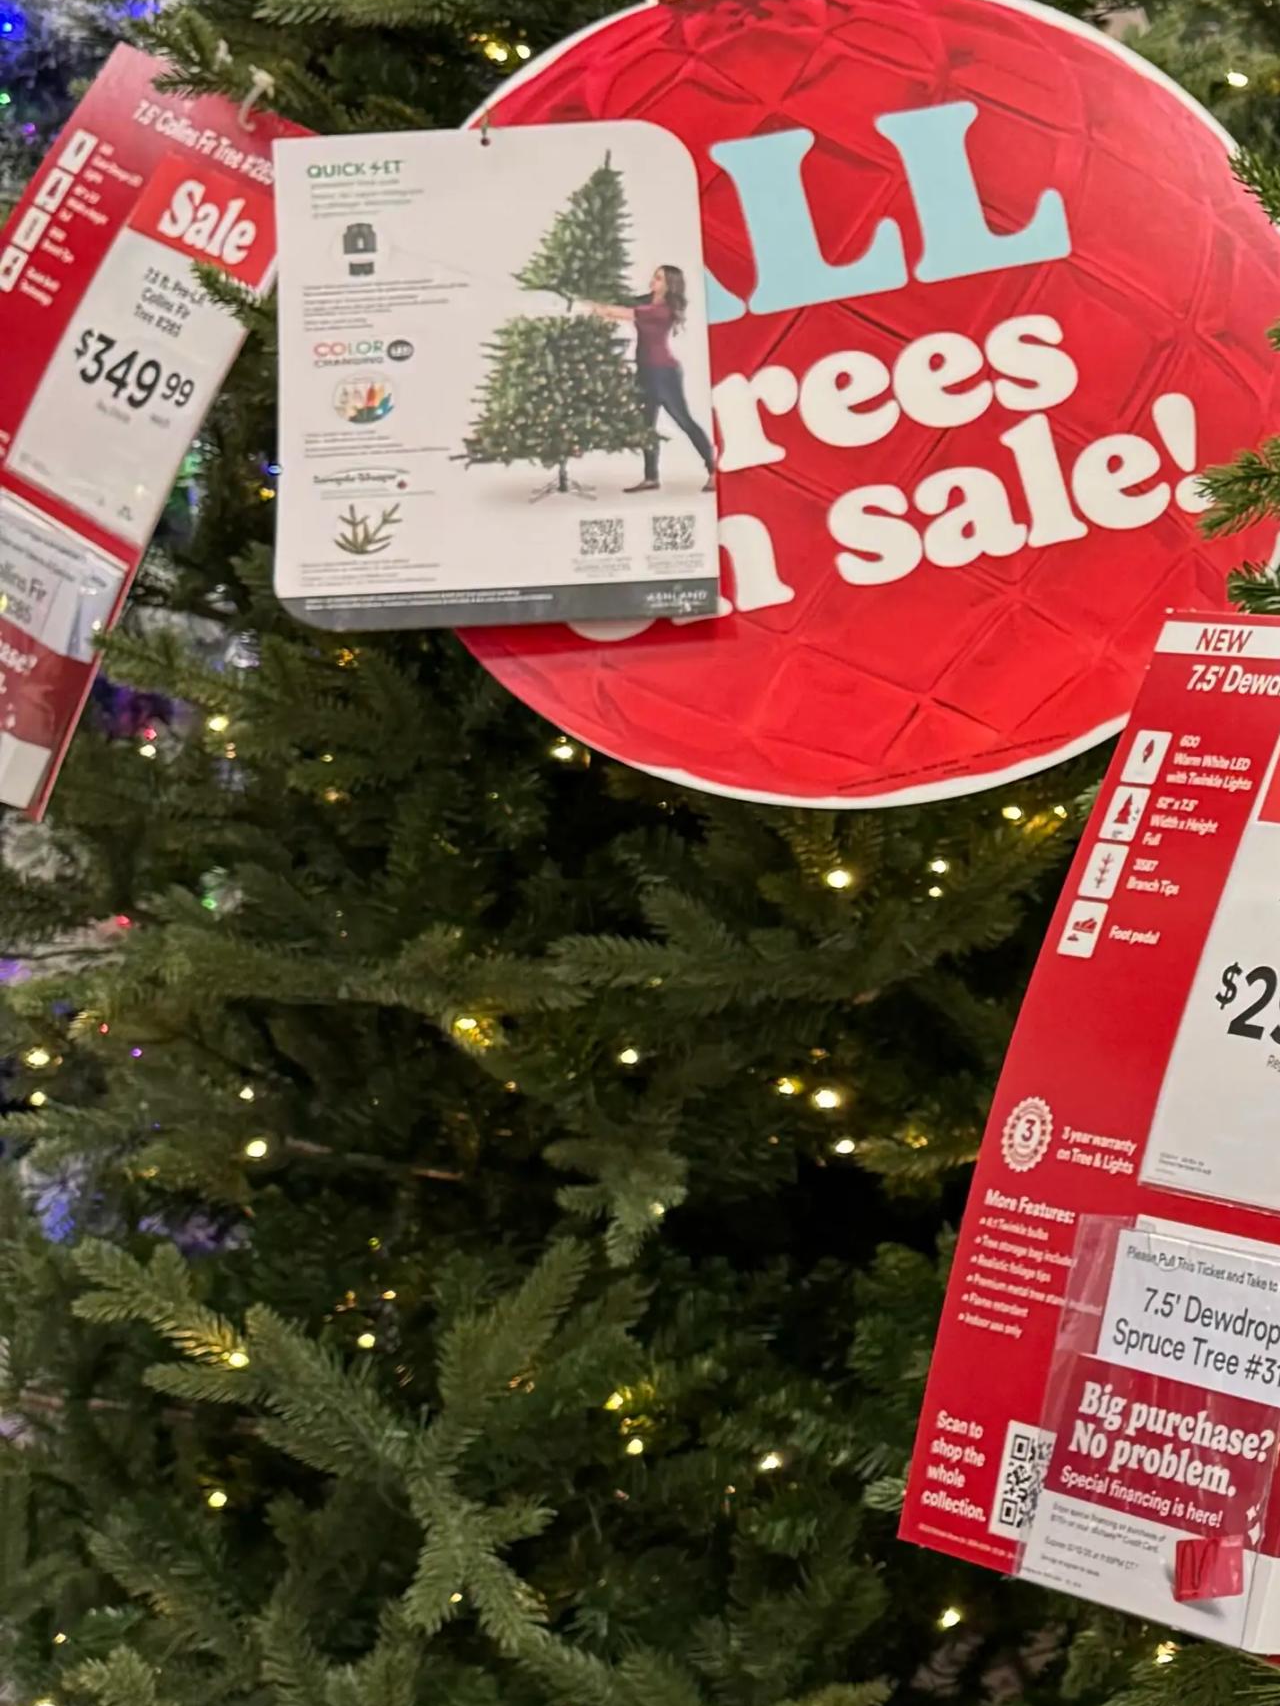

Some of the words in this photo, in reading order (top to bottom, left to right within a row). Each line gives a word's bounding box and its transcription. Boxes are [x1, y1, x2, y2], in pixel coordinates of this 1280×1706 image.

[213, 137, 244, 169] Tree
[307, 163, 366, 178] QUICK
[157, 179, 256, 265] Sale
[704, 101, 1072, 326] LL
[314, 340, 384, 357] COLOR
[73, 327, 161, 409] $349
[712, 314, 1079, 474] rees
[828, 394, 1212, 586] sale!
[1195, 628, 1253, 654] NEW
[1186, 664, 1222, 692] 7.5'
[1202, 755, 1230, 770] White
[1229, 757, 1251, 771] LED
[1188, 772, 1223, 788] Twinkle
[1222, 776, 1253, 792] Lights
[1150, 814, 1178, 829] Width
[1185, 818, 1218, 835] Height
[1126, 876, 1159, 892] Branch
[1160, 880, 1180, 897] Tips
[1109, 925, 1132, 941] Foot
[1129, 930, 1160, 945] pedal
[1021, 1118, 1037, 1142] 3
[1061, 1125, 1072, 1140] 3
[1069, 1130, 1092, 1144] year
[1091, 1134, 1137, 1156] warranty
[1056, 1148, 1071, 1161] on
[1071, 1147, 1093, 1166] Tree
[1101, 1154, 1134, 1174] Lights
[984, 1189, 1017, 1212] More
[1017, 1196, 1076, 1225] Features:
[1127, 1246, 1158, 1266] Please
[1158, 1252, 1178, 1268] Pull
[1178, 1257, 1195, 1273] This
[1197, 1261, 1226, 1280] Ticket
[1226, 1272, 1244, 1286] and
[1246, 1272, 1268, 1291] Take
[1268, 1279, 1279, 1292] to
[1143, 1287, 1182, 1319] 7.5'
[1112, 1318, 1186, 1361] Spruce
[1192, 1336, 1240, 1375] Tree
[936, 1410, 968, 1435] Scan
[968, 1420, 984, 1439] to
[1078, 1381, 1128, 1431] Big
[1124, 1401, 1276, 1464] purchase?
[930, 1437, 962, 1461] shop
[963, 1447, 985, 1468] the
[1068, 1419, 1108, 1459] No
[1108, 1438, 1238, 1498] problem.
[926, 1463, 965, 1488] whole
[921, 1490, 987, 1522] collection.
[1060, 1465, 1109, 1496] Special
[1109, 1481, 1171, 1516] financing
[1172, 1497, 1185, 1516] is
[1187, 1501, 1224, 1529] here!
